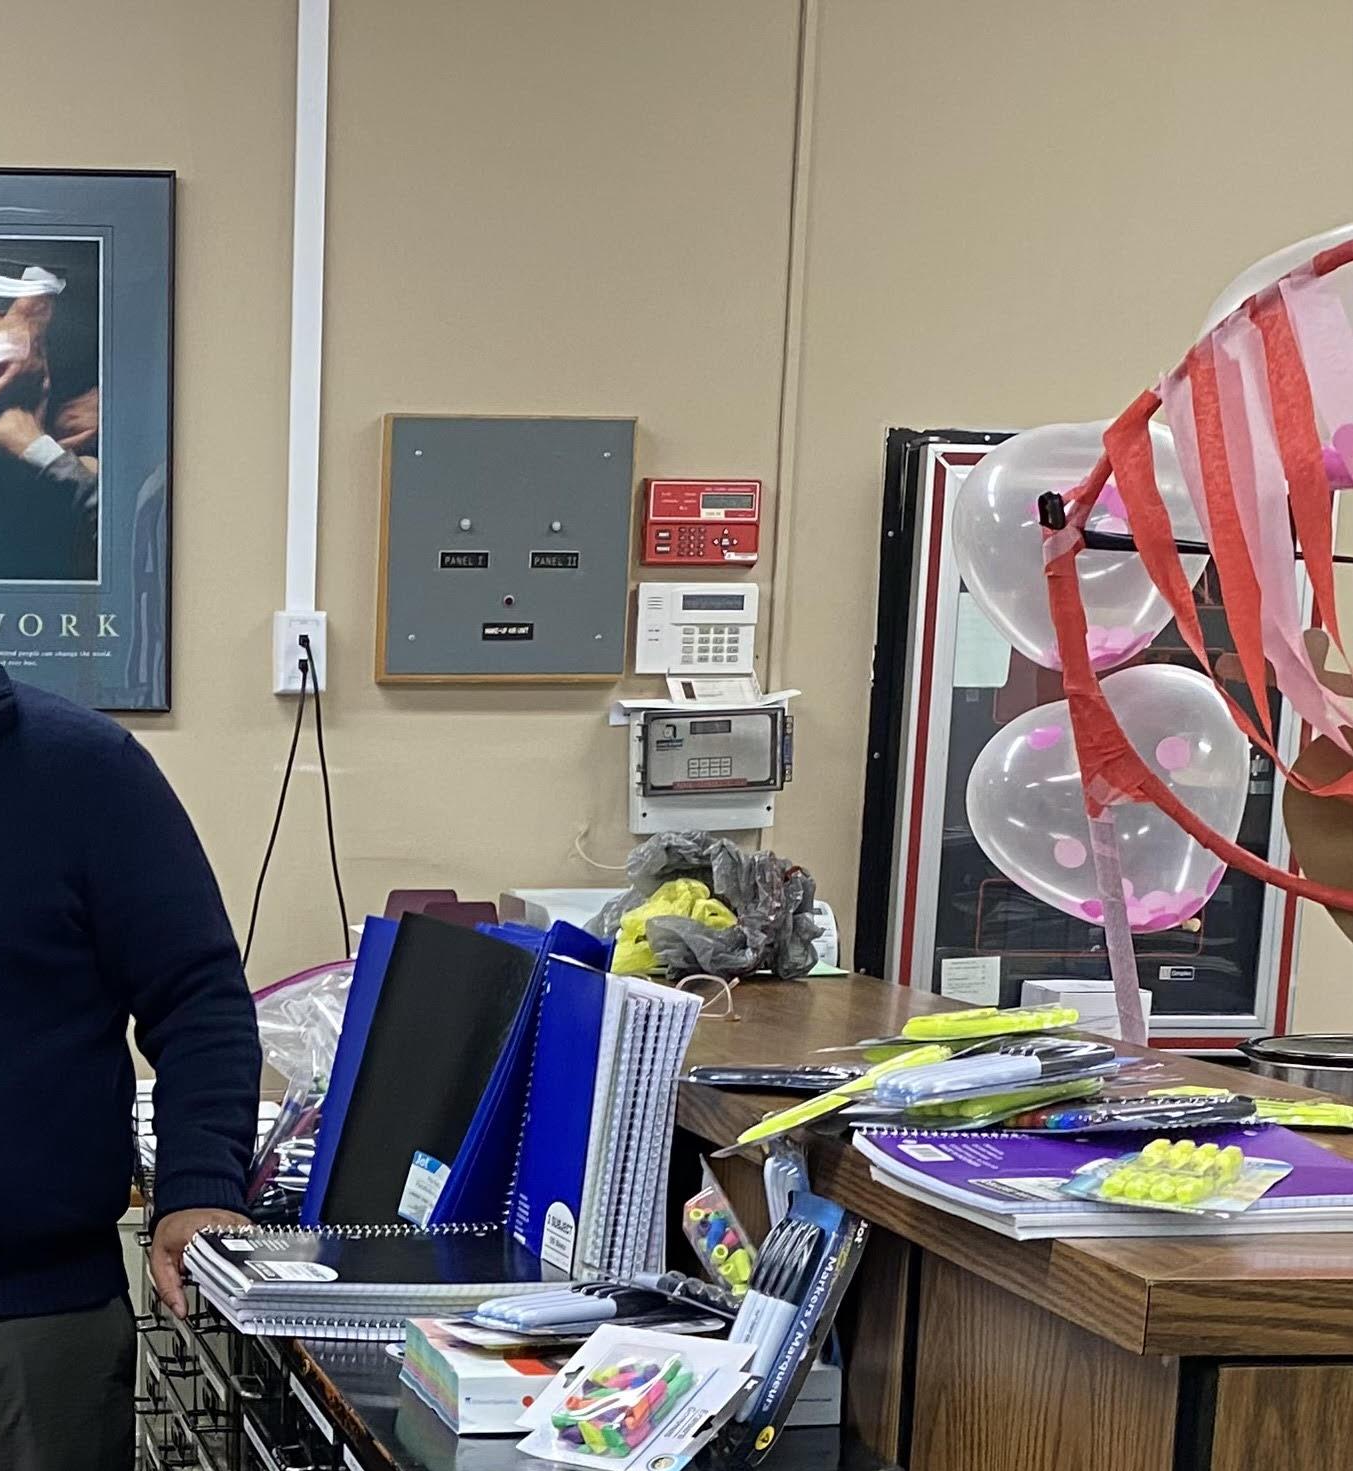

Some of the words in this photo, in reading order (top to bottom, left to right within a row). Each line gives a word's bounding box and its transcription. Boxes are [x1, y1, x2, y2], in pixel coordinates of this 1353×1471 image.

[444, 556, 473, 566] PANEL
[534, 556, 563, 566] PANEL
[804, 1255, 837, 1319] Markers
[762, 1334, 803, 1413] Marqueurs
